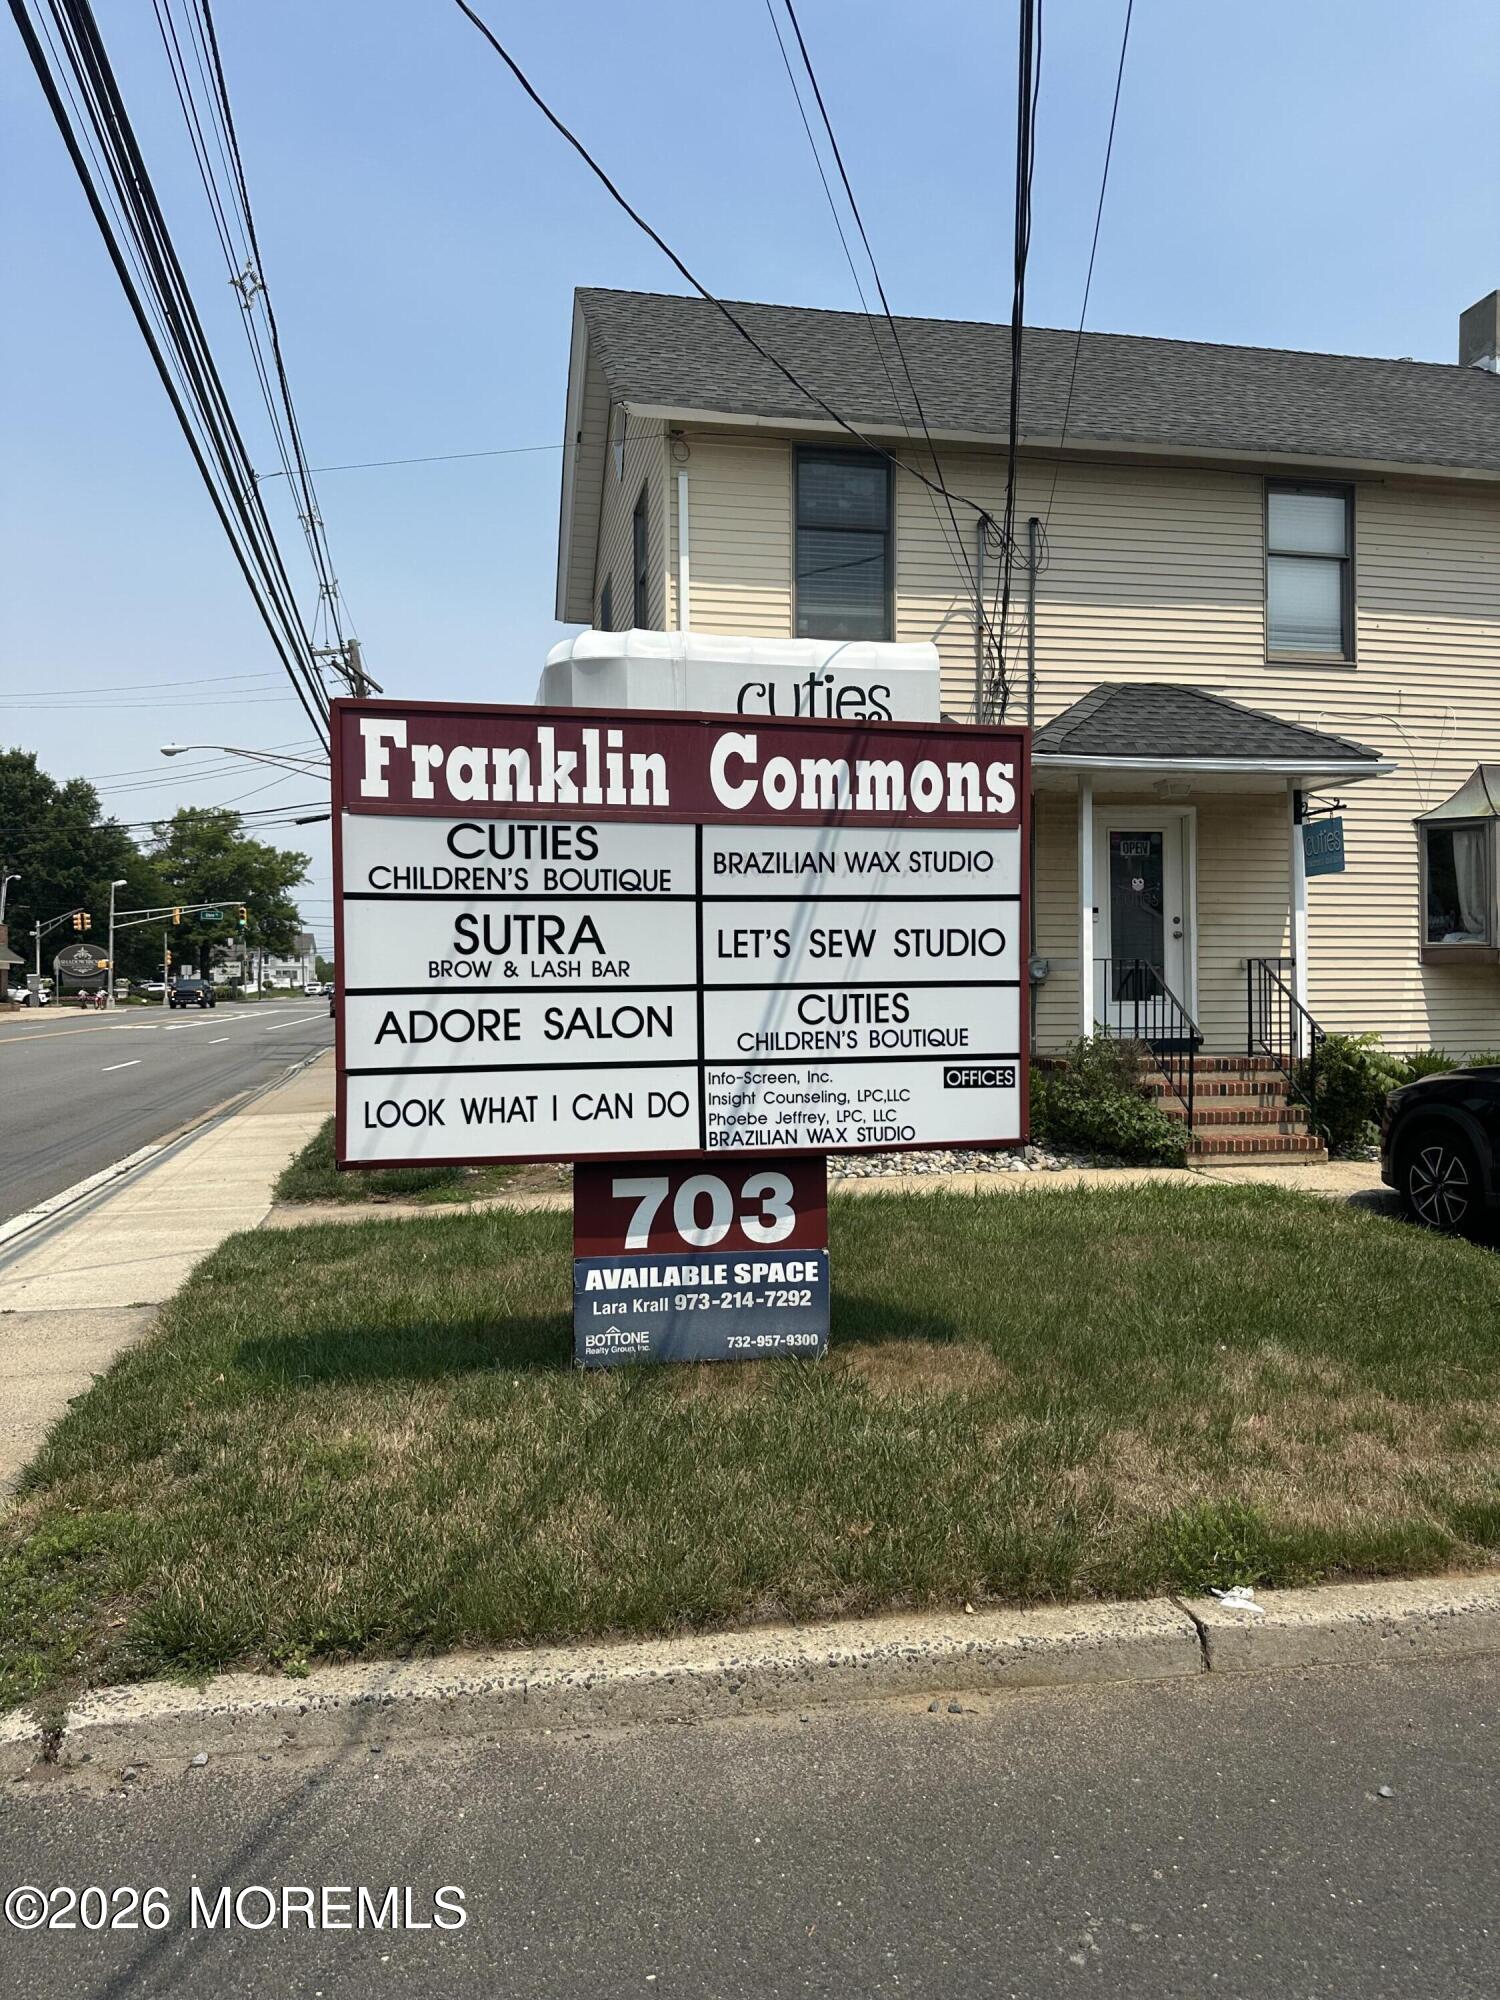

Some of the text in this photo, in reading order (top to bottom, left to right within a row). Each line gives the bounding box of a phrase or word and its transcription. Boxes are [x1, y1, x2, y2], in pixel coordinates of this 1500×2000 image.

[359, 718, 1015, 814] Franklin Commons
[446, 822, 599, 861] CUTIES
[1122, 842, 1149, 855] OPEN
[1305, 830, 1341, 857] cuties
[713, 850, 994, 875] BRAZILIAN WAX STUDIO
[368, 866, 672, 892] CHILDREN'S BOUTIQUE
[453, 913, 606, 956] SUTRA
[717, 927, 1006, 959] LET'S SEW STUDIO
[428, 960, 630, 978] BROW & LASH BAR
[797, 992, 910, 1026] CUTIES
[374, 1005, 673, 1045] ADORE SALON
[736, 1028, 969, 1052] CHILDREN'S BOUTIQUE
[708, 1070, 833, 1086] Info-Screen, Inc.
[946, 1070, 1015, 1086] OFFICES
[364, 1090, 690, 1129] LOOK WHAT I CAN DO
[708, 1088, 911, 1108] Insight Counseling, LPC,LLC
[708, 1108, 897, 1127] Phoebe Jeffrey, LPC, LLC
[708, 1125, 916, 1147] BRAZILIAN WAX STUDIO
[611, 1171, 797, 1250] 703
[584, 1261, 819, 1291] AVAILABLE SPACE
[592, 1289, 812, 1315] Lara Krall 973-214-7292
[585, 1331, 650, 1347] BOTTONE
[585, 1347, 610, 1356] Realty
[637, 1344, 651, 1352] Inc.
[726, 1333, 819, 1349] 732-957-9300
